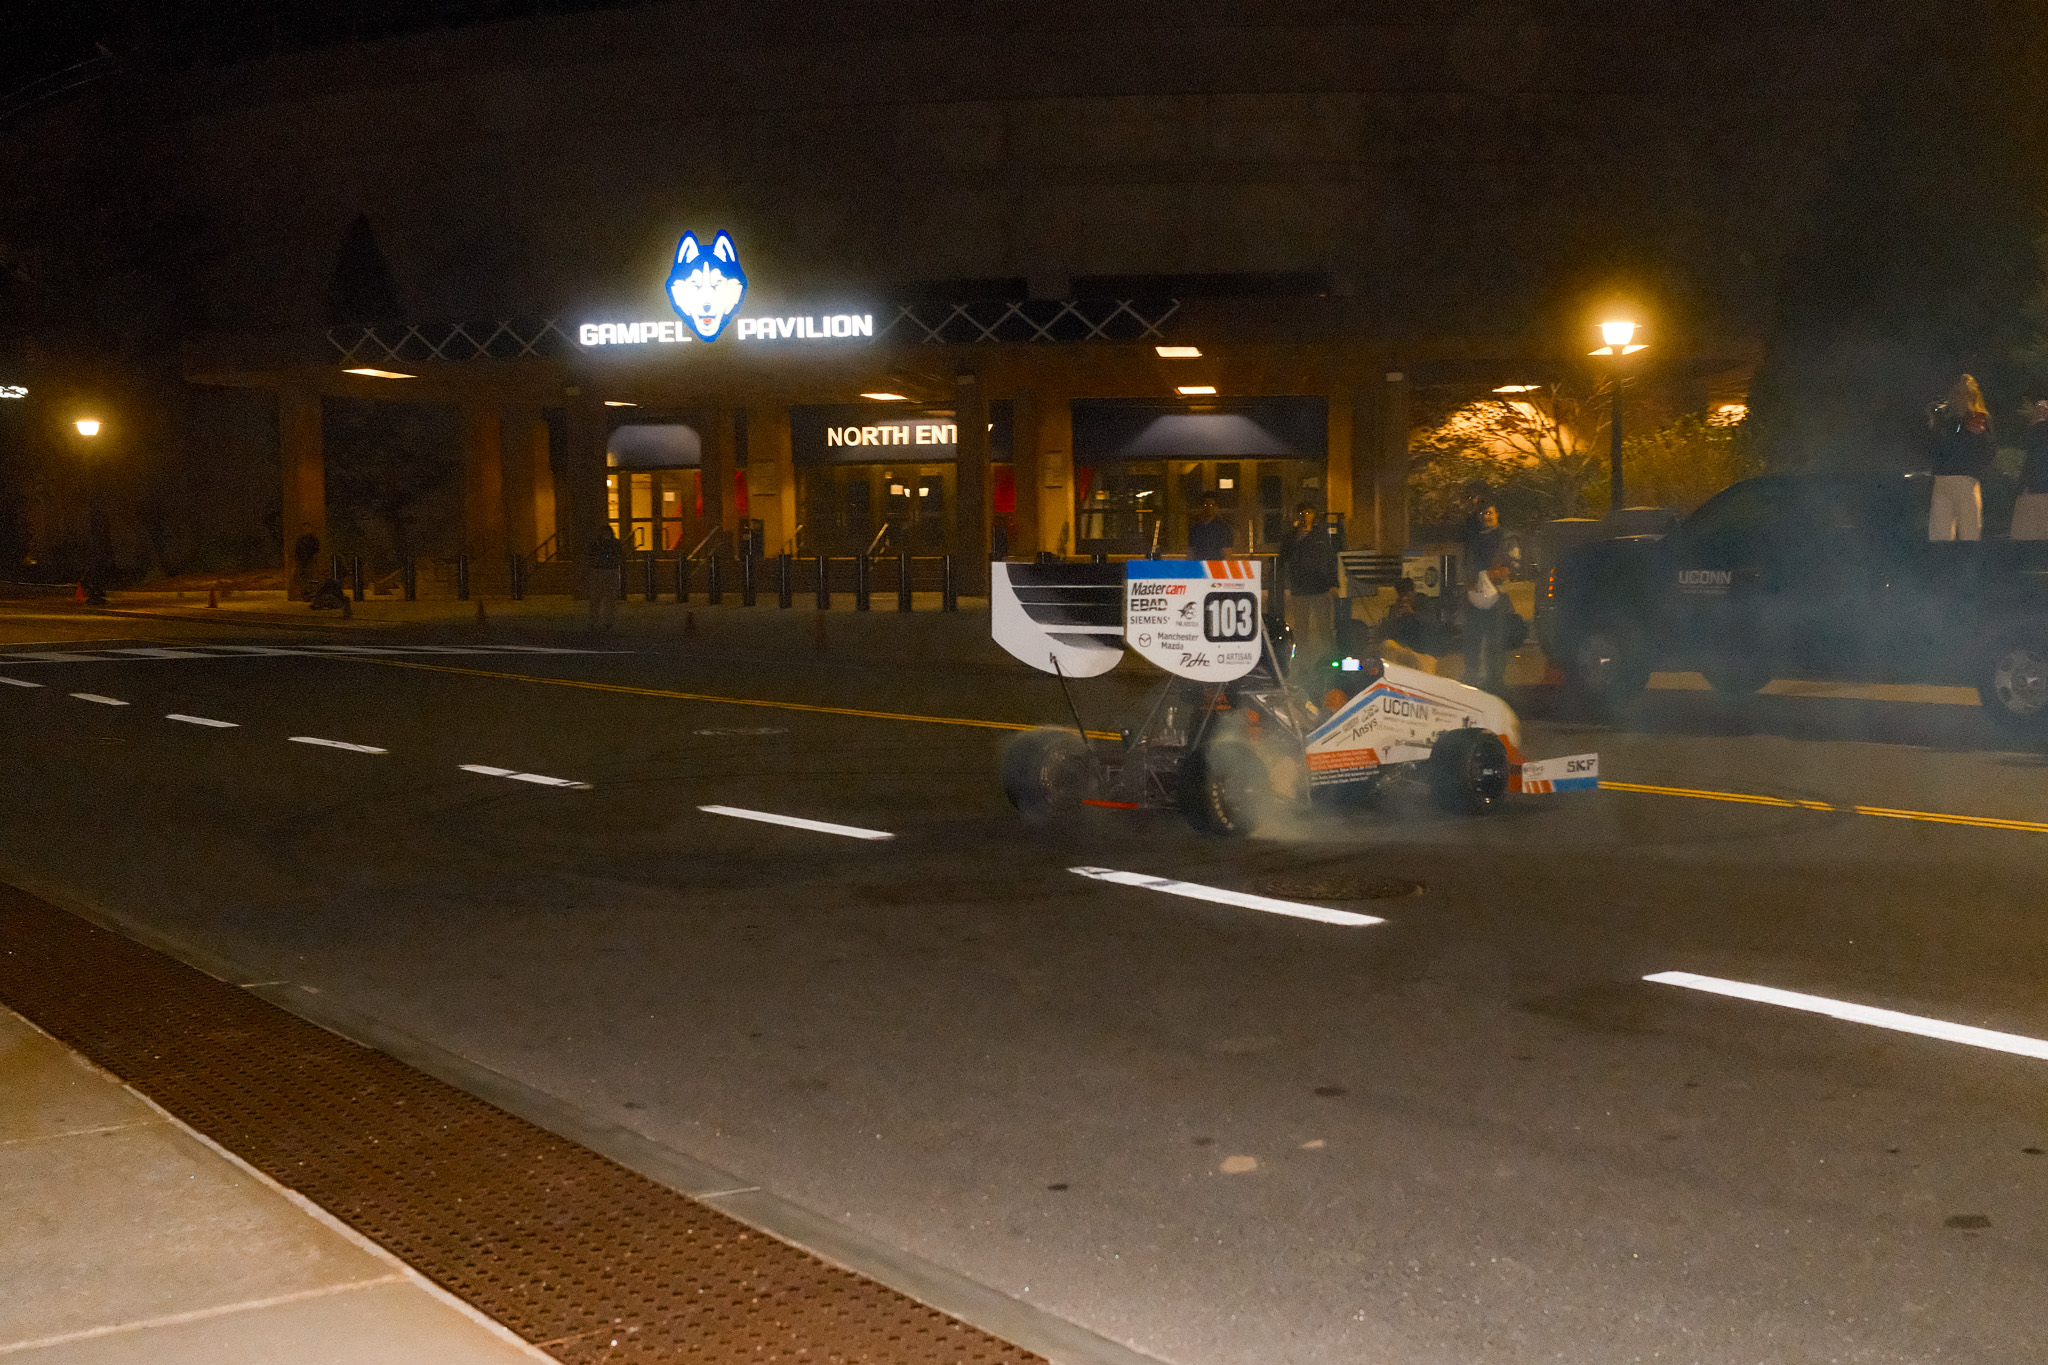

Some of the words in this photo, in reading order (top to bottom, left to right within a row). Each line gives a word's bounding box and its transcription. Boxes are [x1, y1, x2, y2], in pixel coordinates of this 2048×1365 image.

[579, 321, 692, 346] GAMPEL
[737, 314, 873, 341] PAVILION
[827, 425, 910, 447] NORTH
[1678, 570, 1732, 585] UCONN
[1131, 583, 1186, 596] Mastercam
[1131, 599, 1168, 612] EBAD
[1130, 616, 1168, 625] SIEMENS
[1209, 599, 1252, 638] 103
[1158, 632, 1199, 641] Manchester
[1161, 641, 1184, 650] Mazda
[1382, 697, 1429, 721] UCONN
[1352, 717, 1379, 741] Ansys
[1566, 758, 1596, 773] SKF
